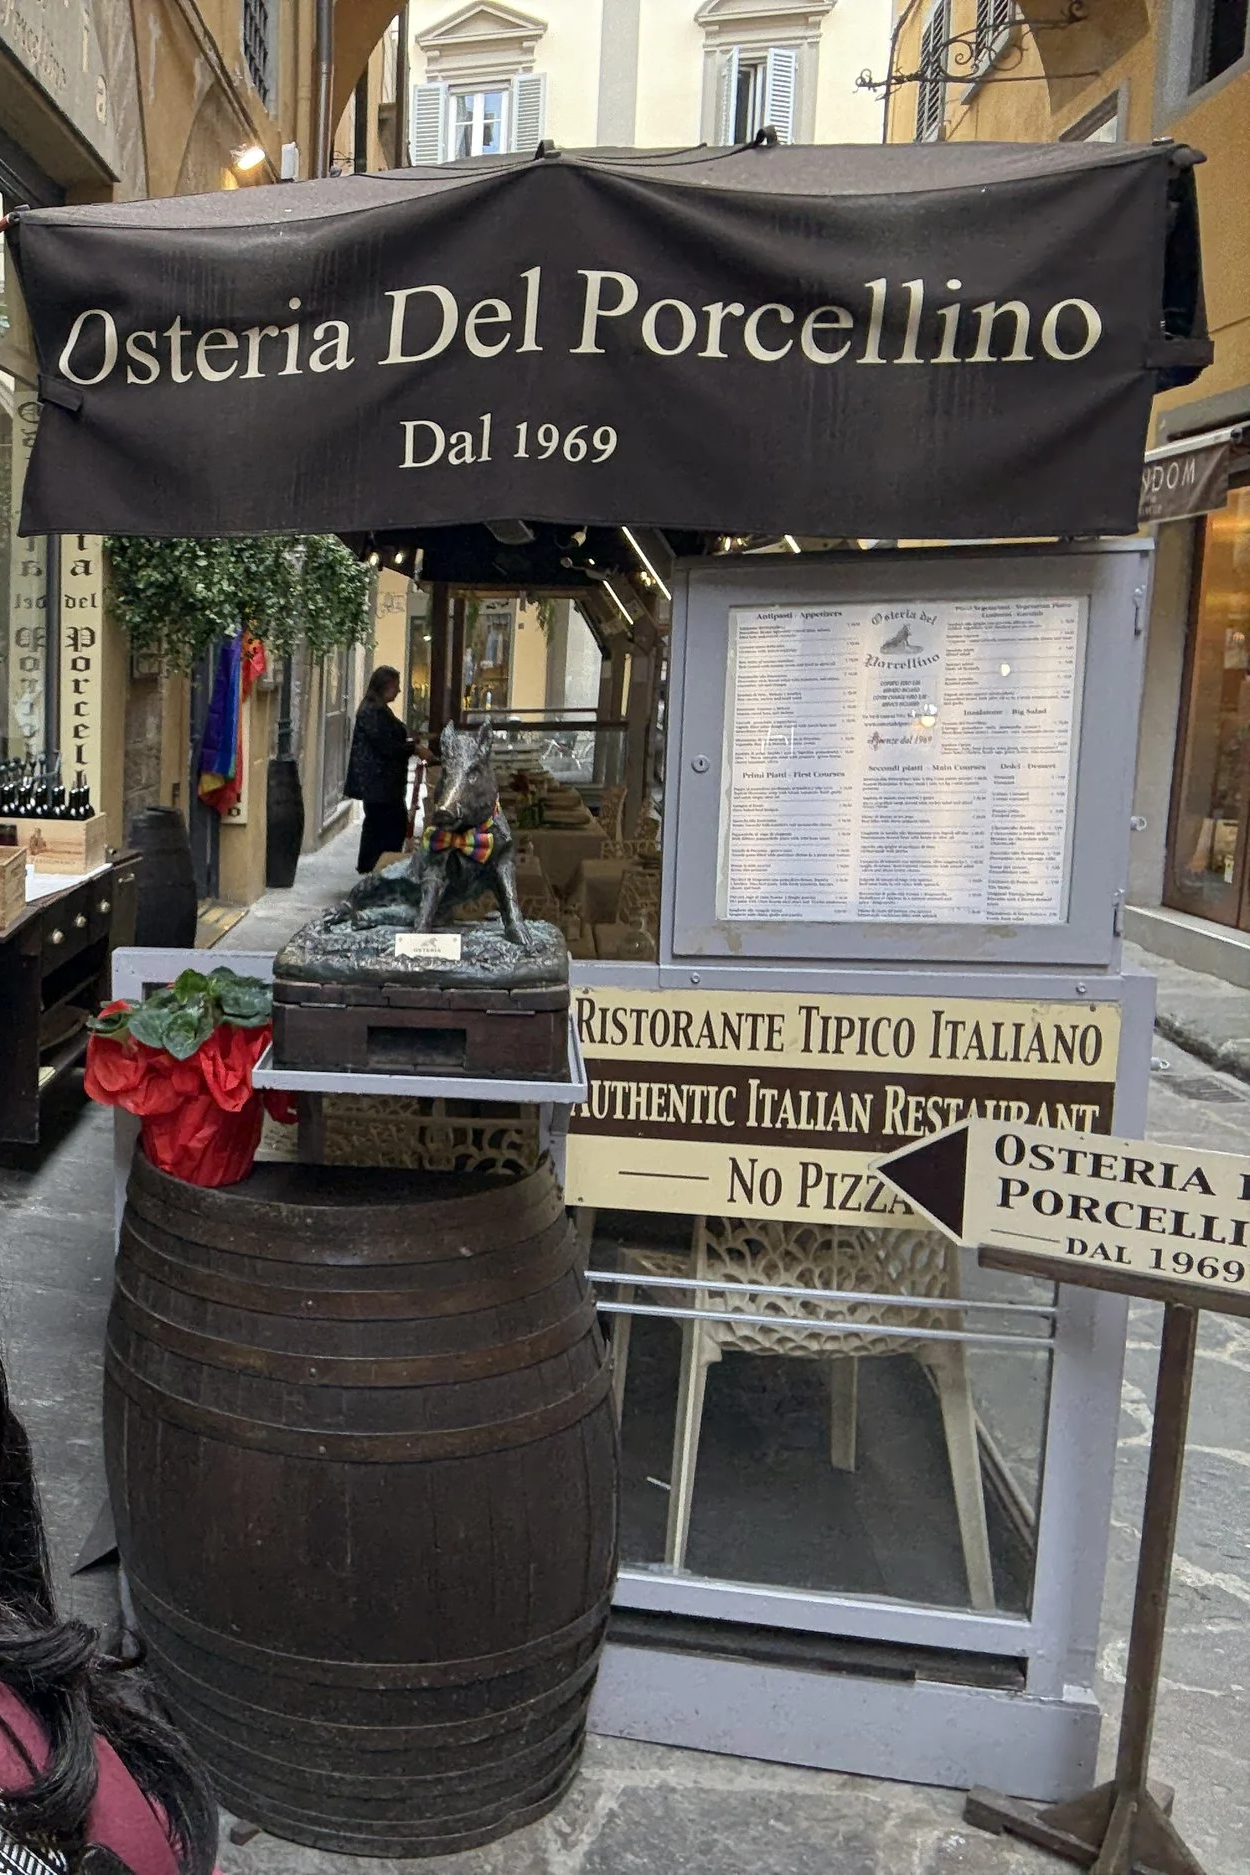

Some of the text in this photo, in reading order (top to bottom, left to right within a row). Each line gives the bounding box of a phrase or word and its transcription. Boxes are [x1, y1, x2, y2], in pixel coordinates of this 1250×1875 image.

[58, 266, 1102, 385] Osteria Del Porcellino
[399, 412, 618, 469] Dal 1969
[64, 592, 98, 609] del
[799, 610, 843, 620] Appetizers
[871, 608, 917, 626] Osteria
[575, 997, 1103, 1067] RISTORANTE TIPICO ITALIANO
[746, 1077, 874, 1134] ITALIAN
[727, 1156, 783, 1207] NO
[994, 1133, 1217, 1197] OSTERIA
[1066, 1236, 1245, 1284] DAL 1969
